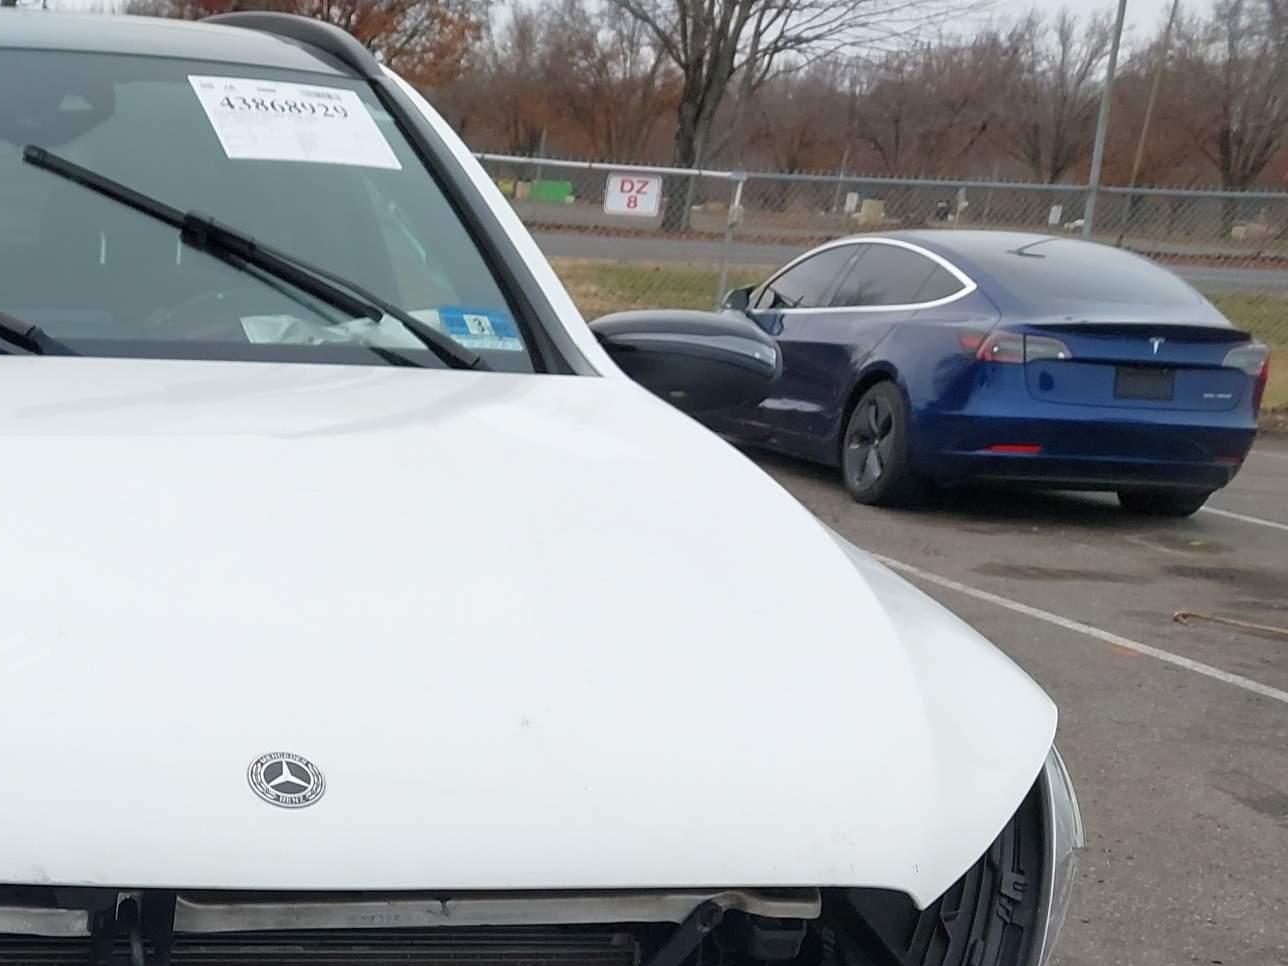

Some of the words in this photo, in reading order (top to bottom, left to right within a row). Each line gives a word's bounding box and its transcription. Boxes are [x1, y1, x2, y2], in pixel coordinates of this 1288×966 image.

[219, 95, 350, 120] 43868929
[620, 178, 649, 195] DZ
[626, 195, 638, 209] 8
